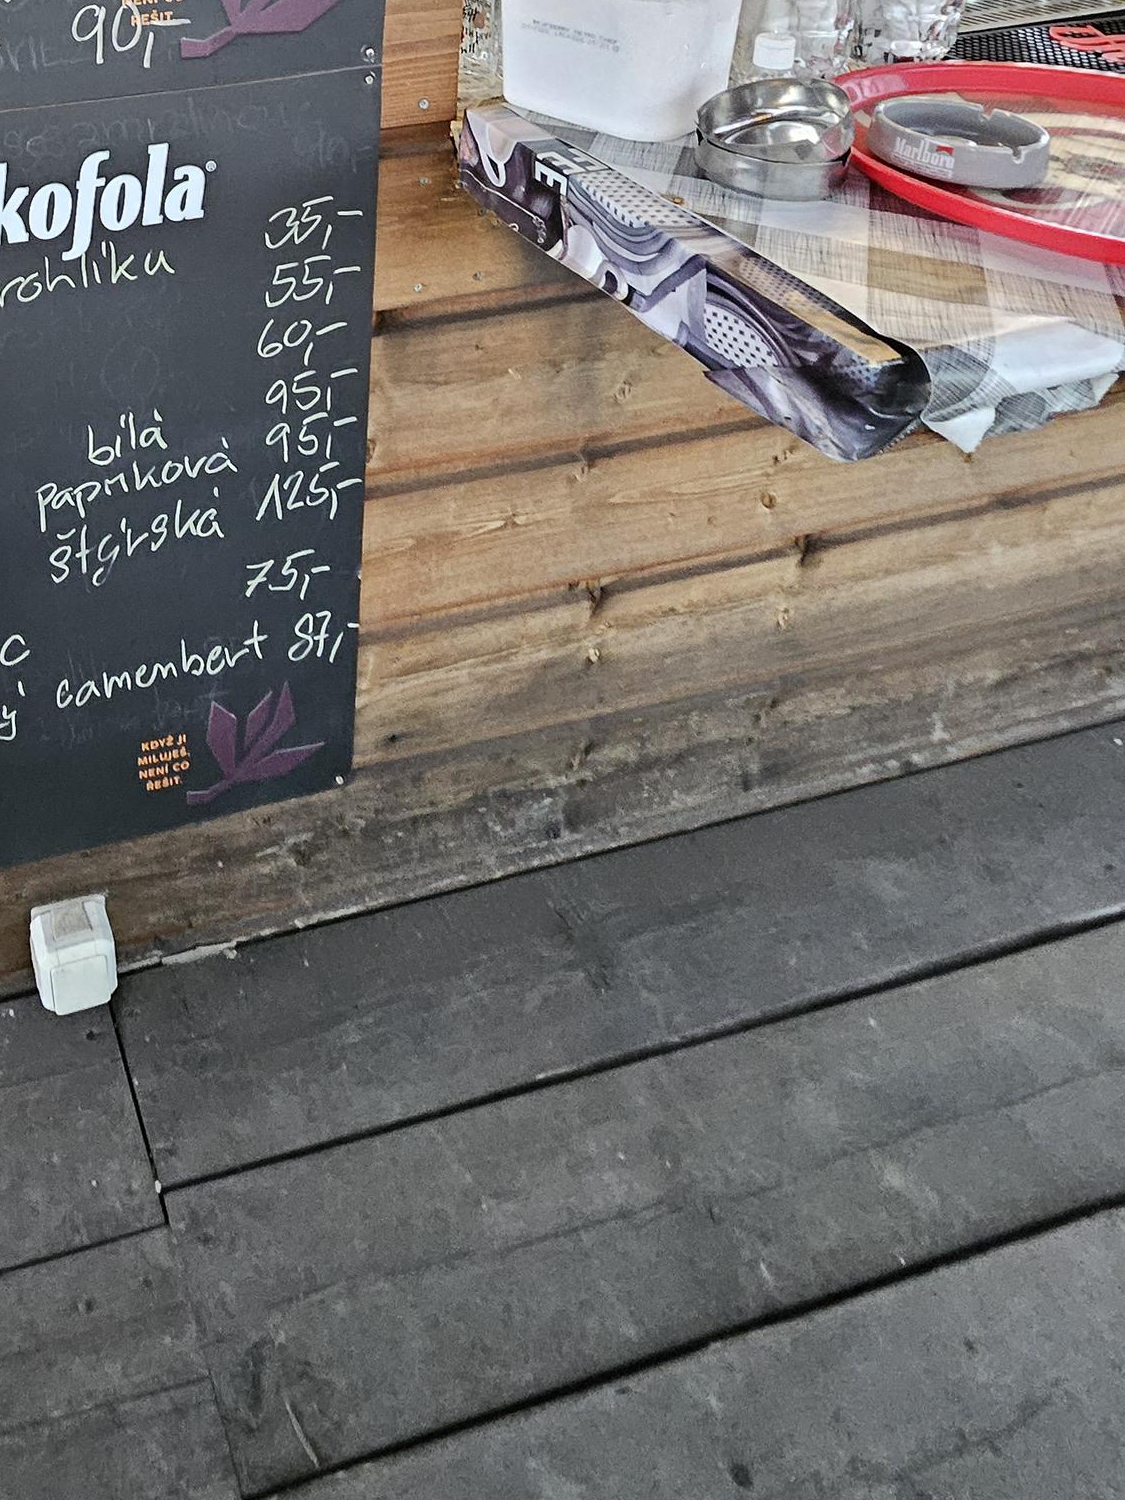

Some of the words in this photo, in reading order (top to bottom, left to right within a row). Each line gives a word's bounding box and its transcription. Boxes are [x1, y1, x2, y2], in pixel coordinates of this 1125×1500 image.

[894, 137, 956, 169] Marlboro
[55, 619, 268, 711] camembert
[141, 734, 174, 752] KDYŽ
[176, 733, 187, 746] JI
[138, 762, 169, 780] NENÍ
[172, 760, 191, 772] CO
